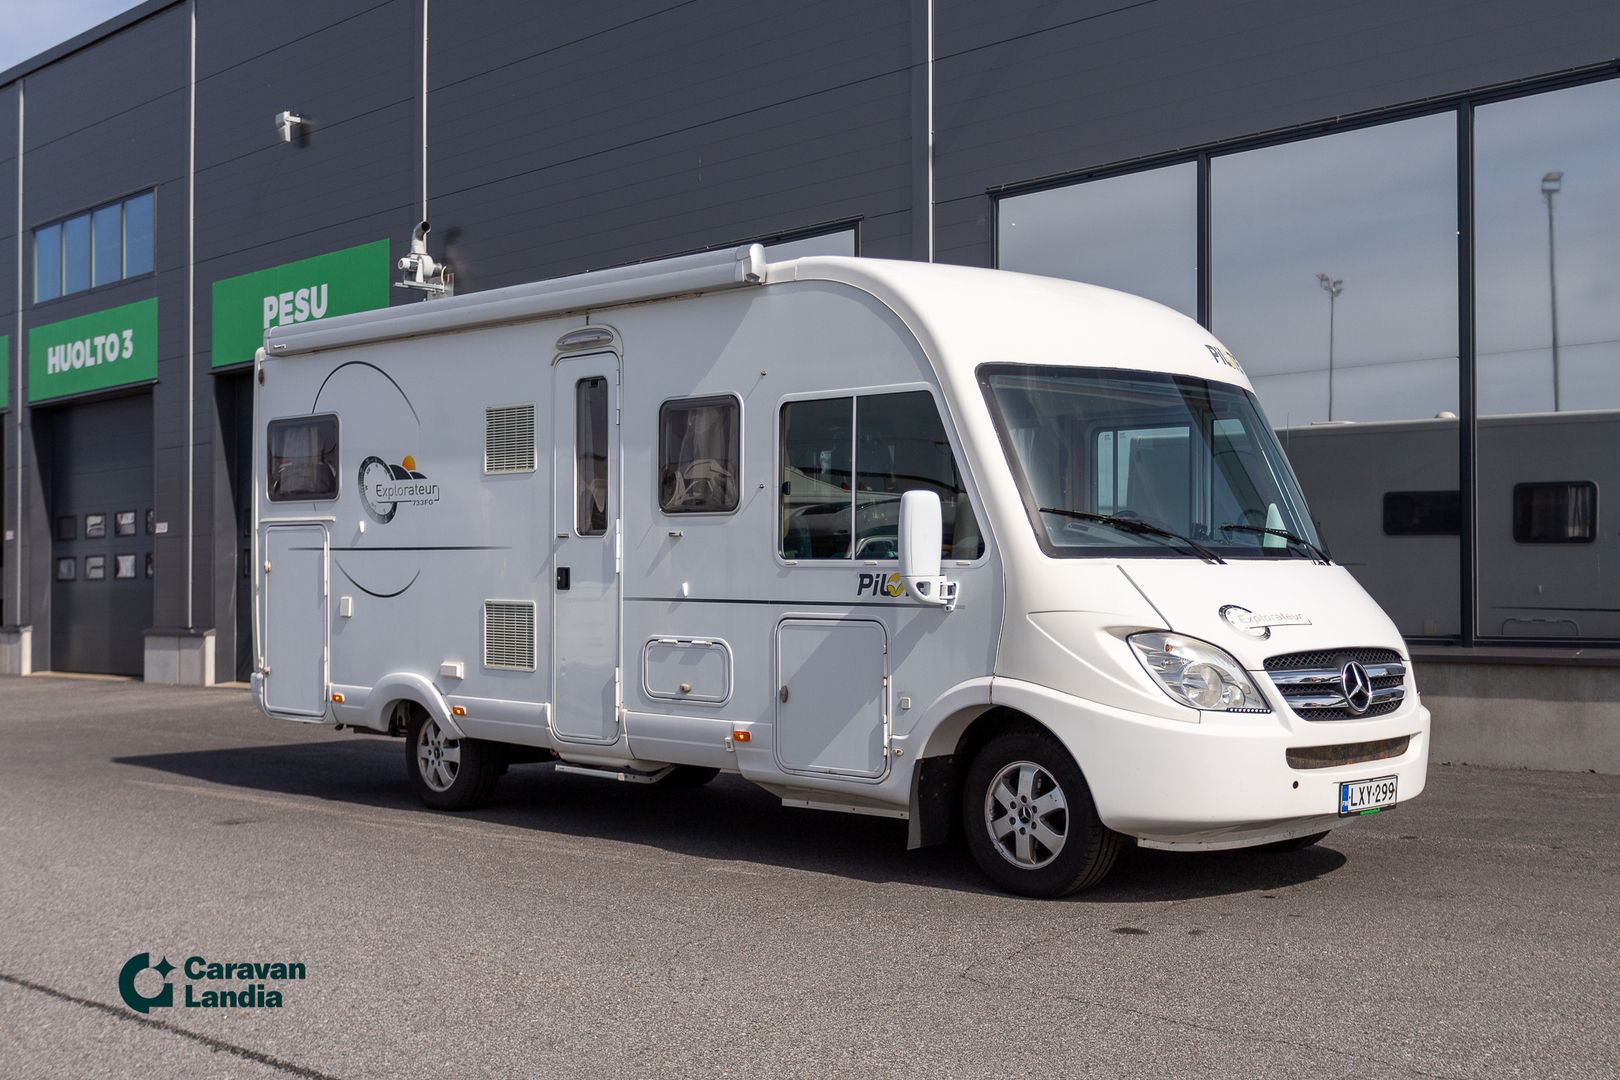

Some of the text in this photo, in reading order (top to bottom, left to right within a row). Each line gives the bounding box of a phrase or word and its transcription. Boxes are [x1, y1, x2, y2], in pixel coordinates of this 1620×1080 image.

[263, 283, 329, 328] PESU
[47, 329, 134, 374] HUOLTO 3
[375, 483, 437, 499] Explorateur
[1237, 613, 1303, 625] Explorateur
[1350, 782, 1396, 807] LXY-299
